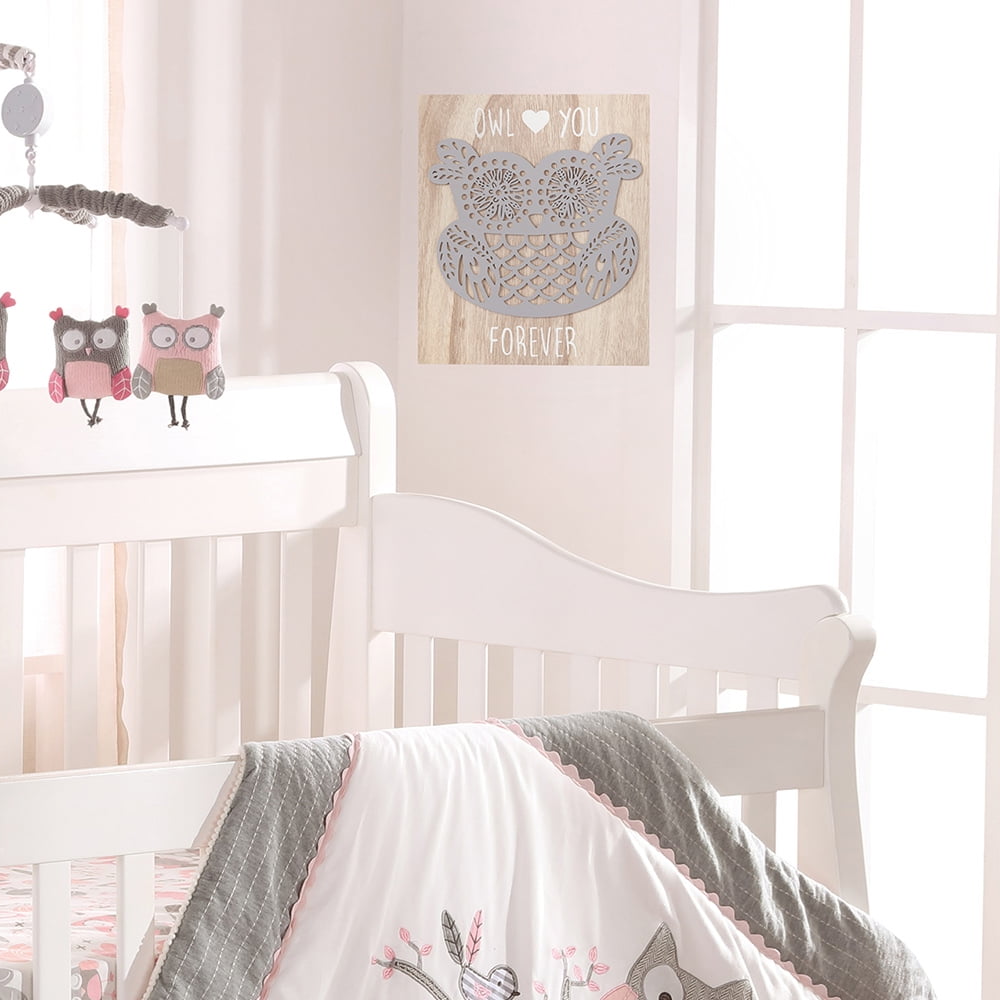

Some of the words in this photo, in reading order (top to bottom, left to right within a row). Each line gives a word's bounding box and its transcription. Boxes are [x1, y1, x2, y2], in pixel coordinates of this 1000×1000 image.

[474, 107, 514, 138] OWL
[559, 107, 599, 137] YOU
[489, 326, 577, 357] FOREVER
